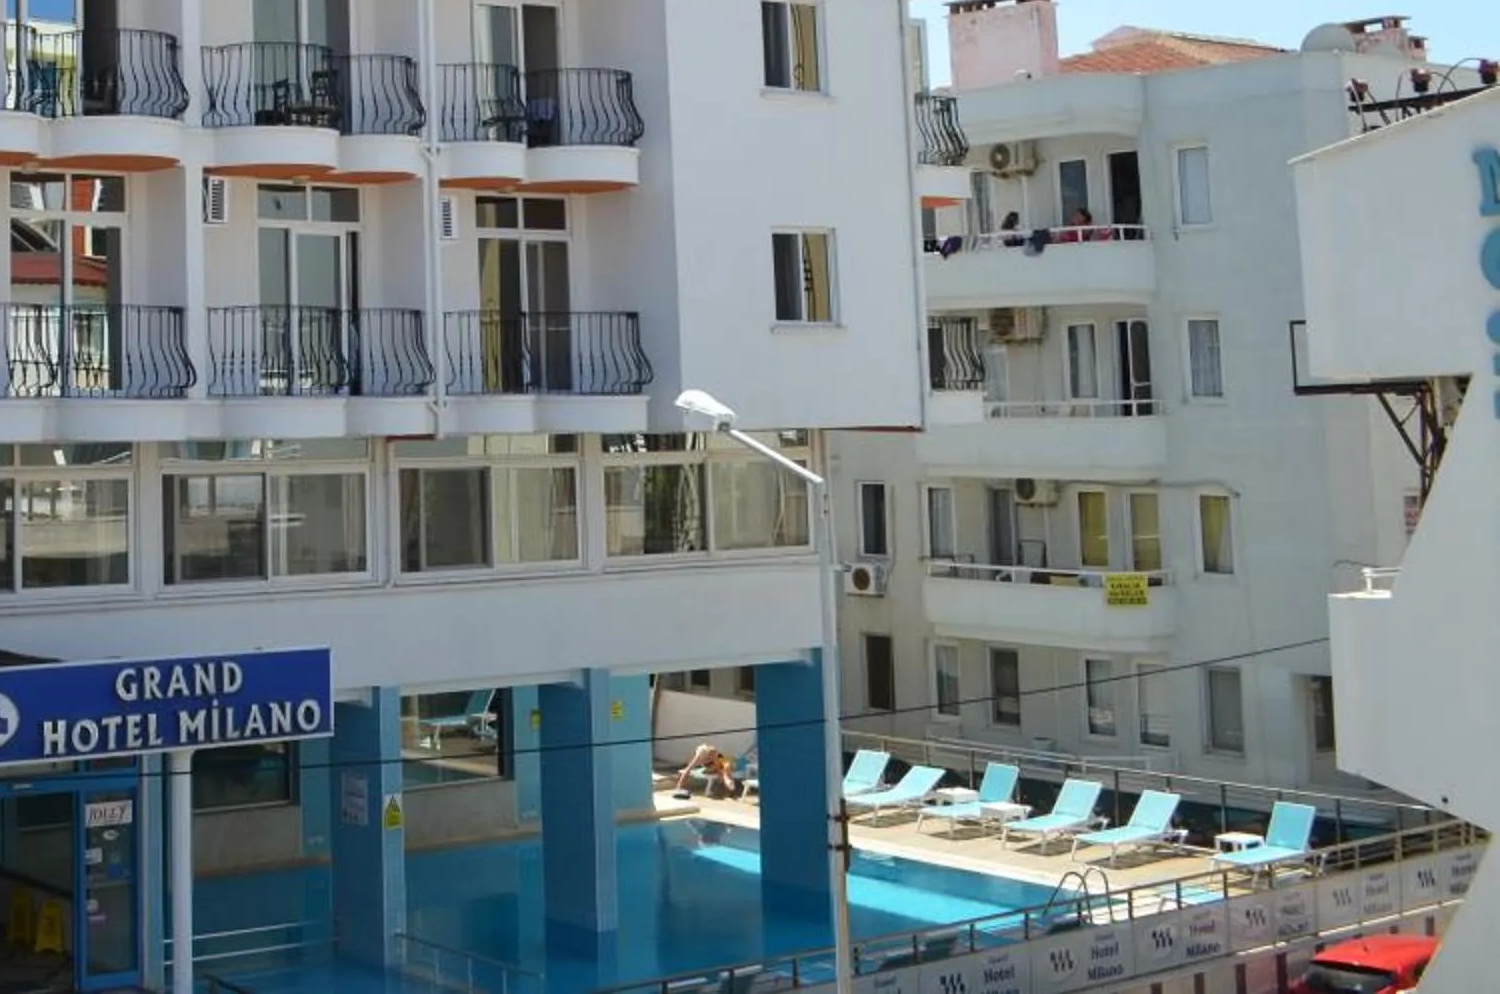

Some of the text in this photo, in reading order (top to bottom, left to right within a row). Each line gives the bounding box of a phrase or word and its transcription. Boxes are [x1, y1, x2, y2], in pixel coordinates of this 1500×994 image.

[115, 660, 243, 702] GRAND
[43, 699, 321, 755] HOTEL MİLANO
